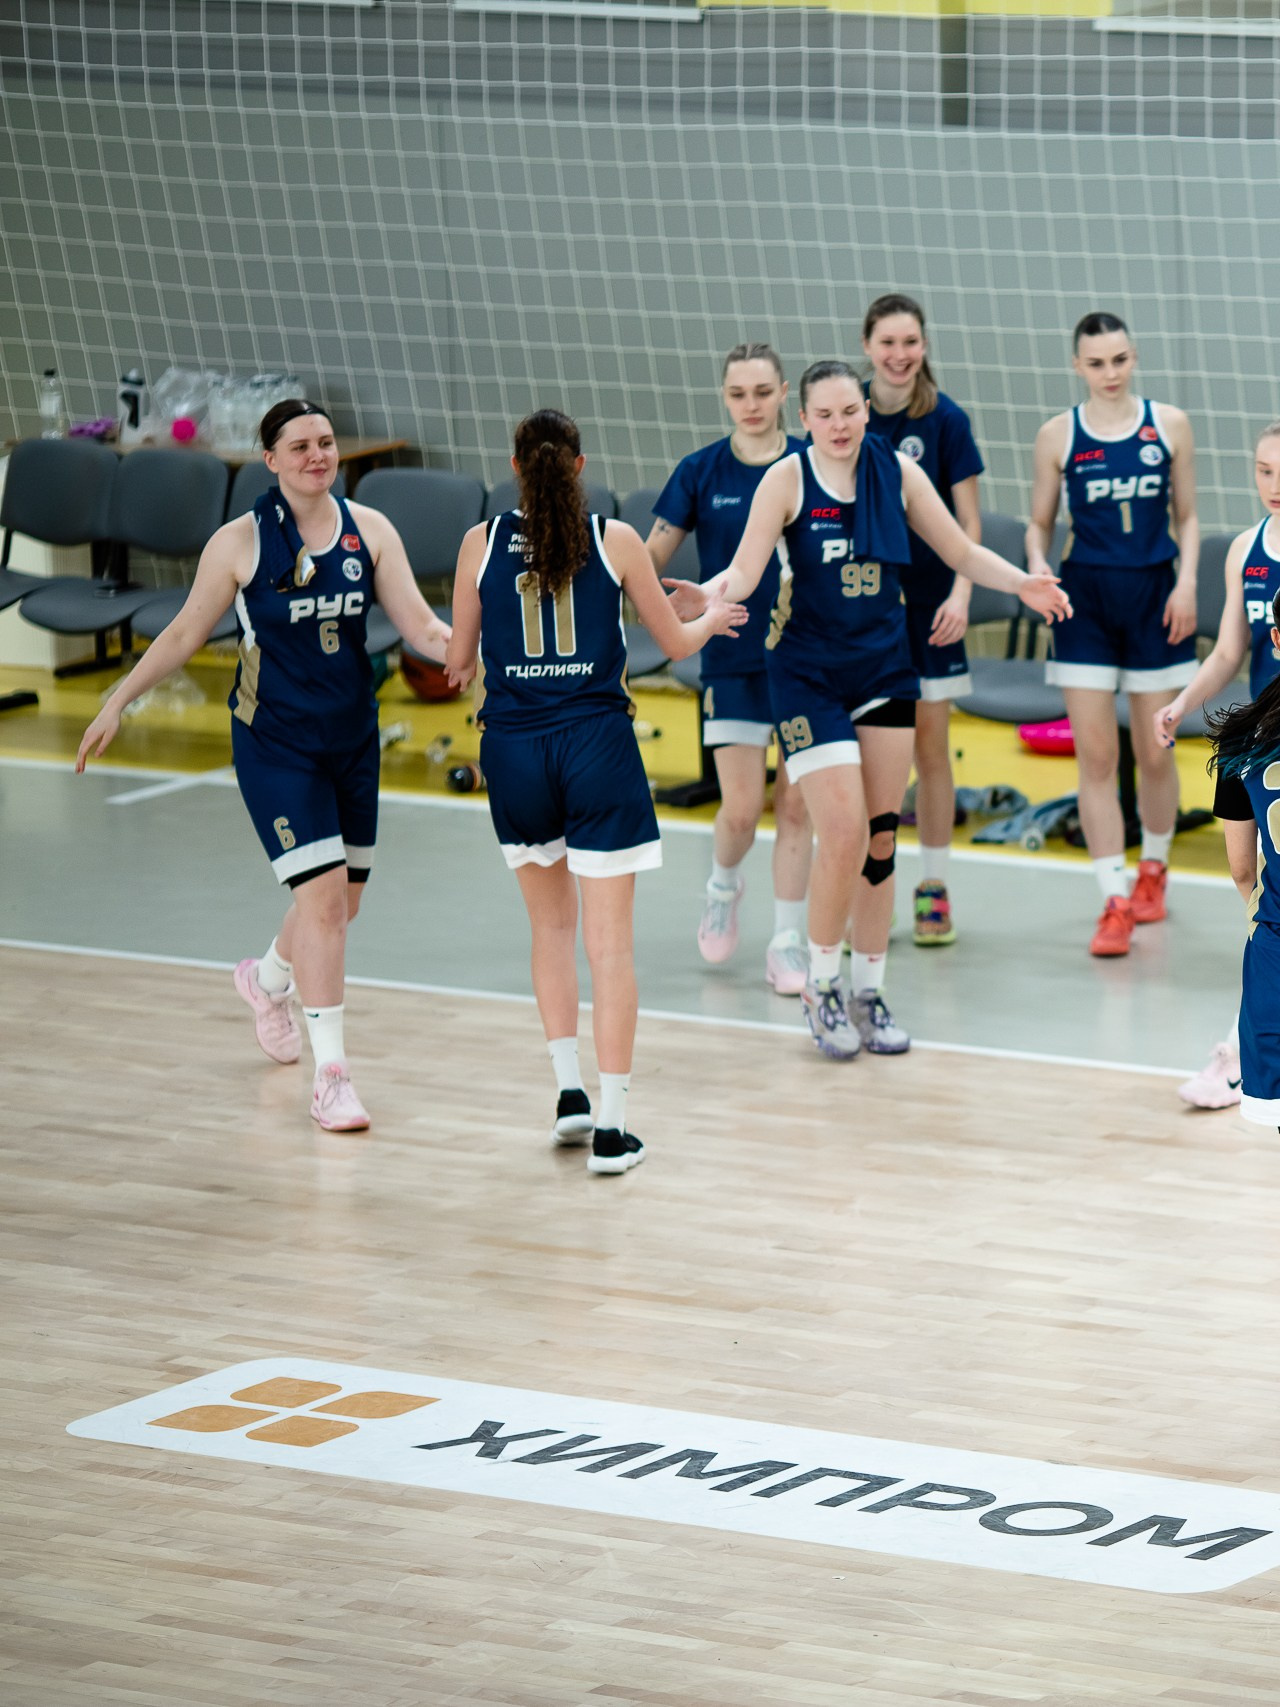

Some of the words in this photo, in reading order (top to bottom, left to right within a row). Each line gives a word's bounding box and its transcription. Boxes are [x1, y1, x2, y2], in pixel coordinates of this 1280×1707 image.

[1087, 475, 1161, 503] РУС
[1119, 501, 1133, 534] 1
[841, 562, 881, 598] 99
[289, 591, 364, 624] РУС
[515, 571, 577, 658] 11
[319, 620, 340, 655] 6
[505, 662, 594, 679] ГЦОЛИФК
[779, 715, 813, 752] 99
[273, 815, 297, 851] 6
[410, 1419, 1275, 1562] ХИМПРОМ
